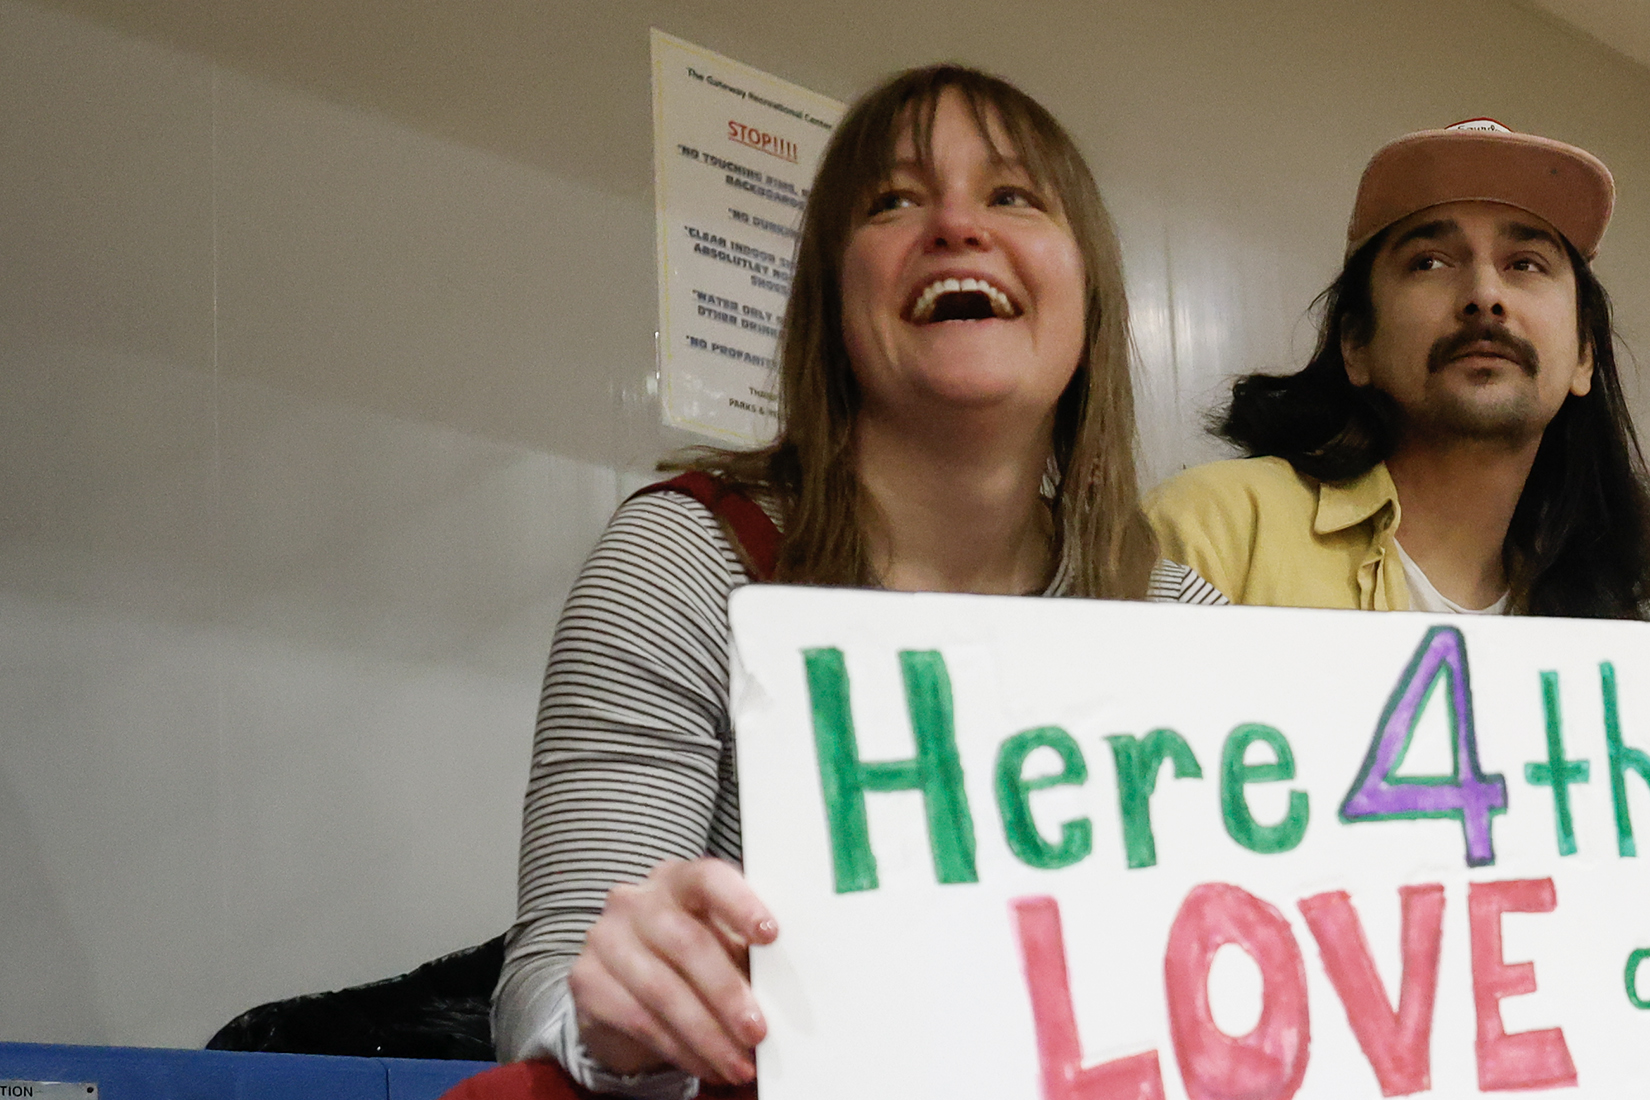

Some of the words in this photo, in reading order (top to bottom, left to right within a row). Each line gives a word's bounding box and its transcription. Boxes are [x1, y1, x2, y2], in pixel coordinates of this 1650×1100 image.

[686, 66, 704, 82] The
[706, 75, 747, 99] Gateway
[728, 120, 799, 161] STOP!!!!
[702, 152, 763, 183] TOUCHING
[697, 304, 738, 326] OTHER
[801, 646, 1310, 894] Here
[1338, 625, 1508, 868] 4
